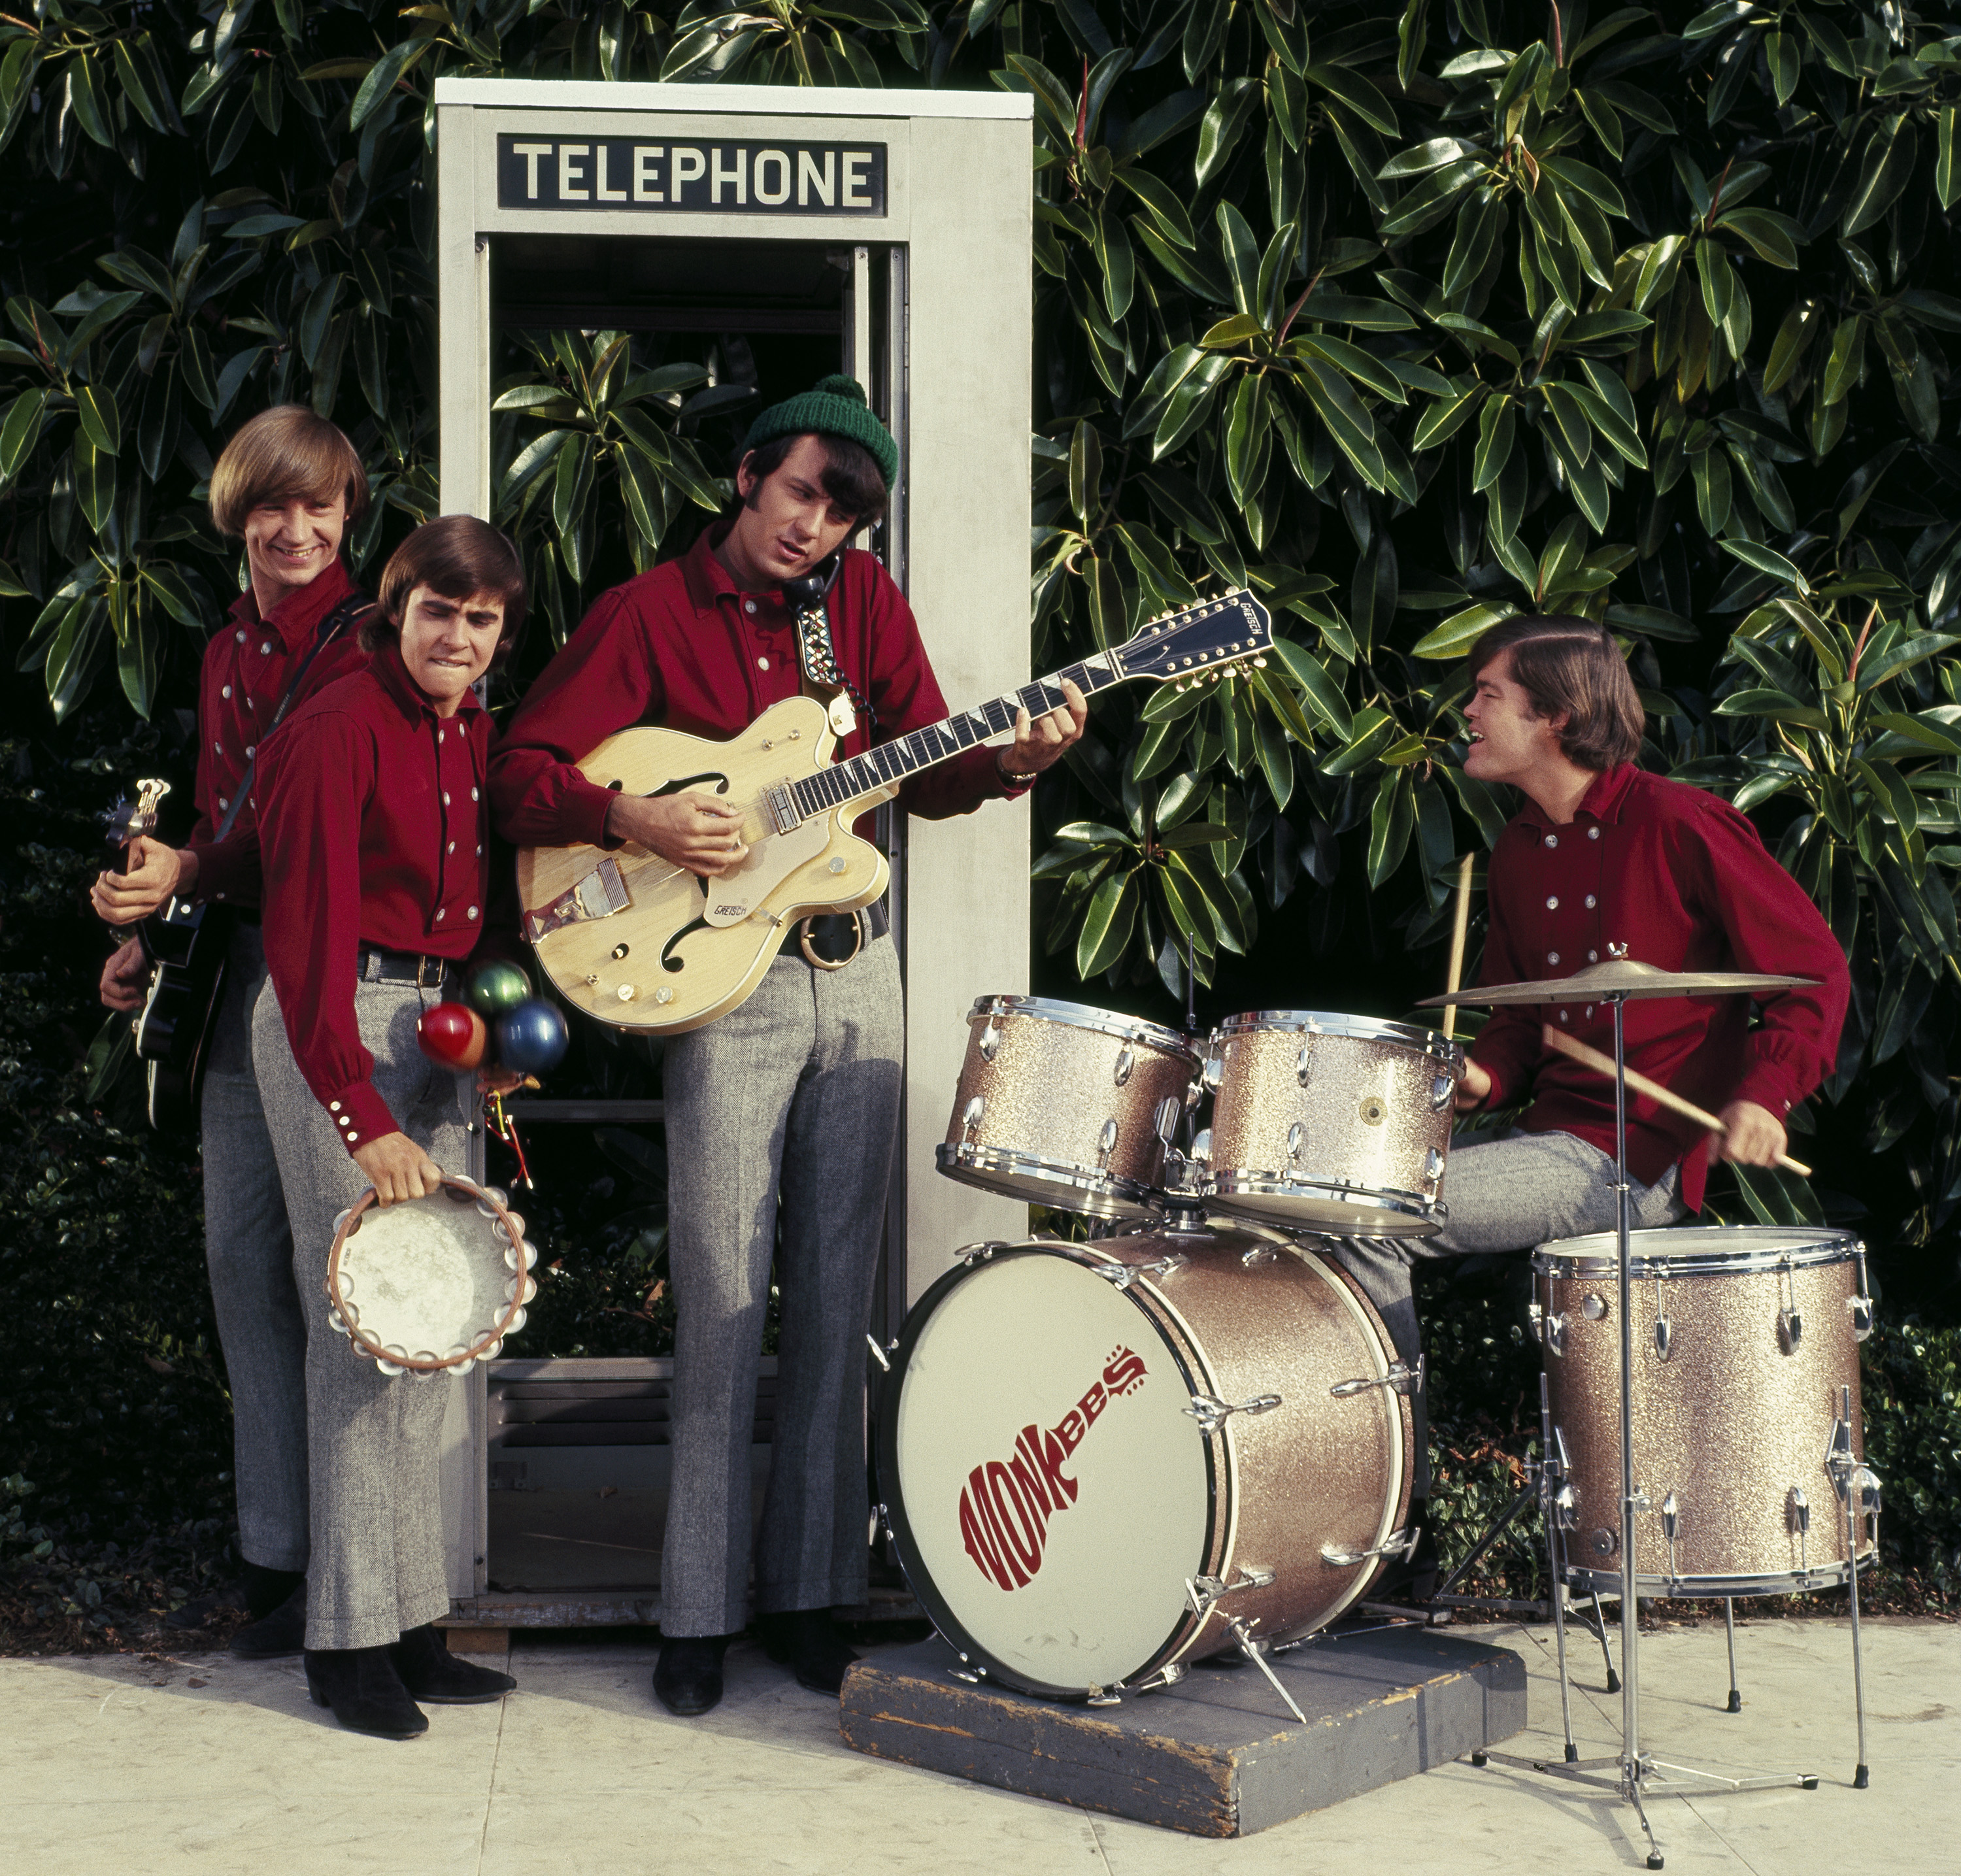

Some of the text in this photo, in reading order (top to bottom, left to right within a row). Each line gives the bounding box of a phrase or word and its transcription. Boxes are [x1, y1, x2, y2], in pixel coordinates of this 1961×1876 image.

[513, 143, 872, 207] TELEPHONE
[1240, 603, 1263, 634] GRETSCH
[714, 905, 746, 915] GRETSCH
